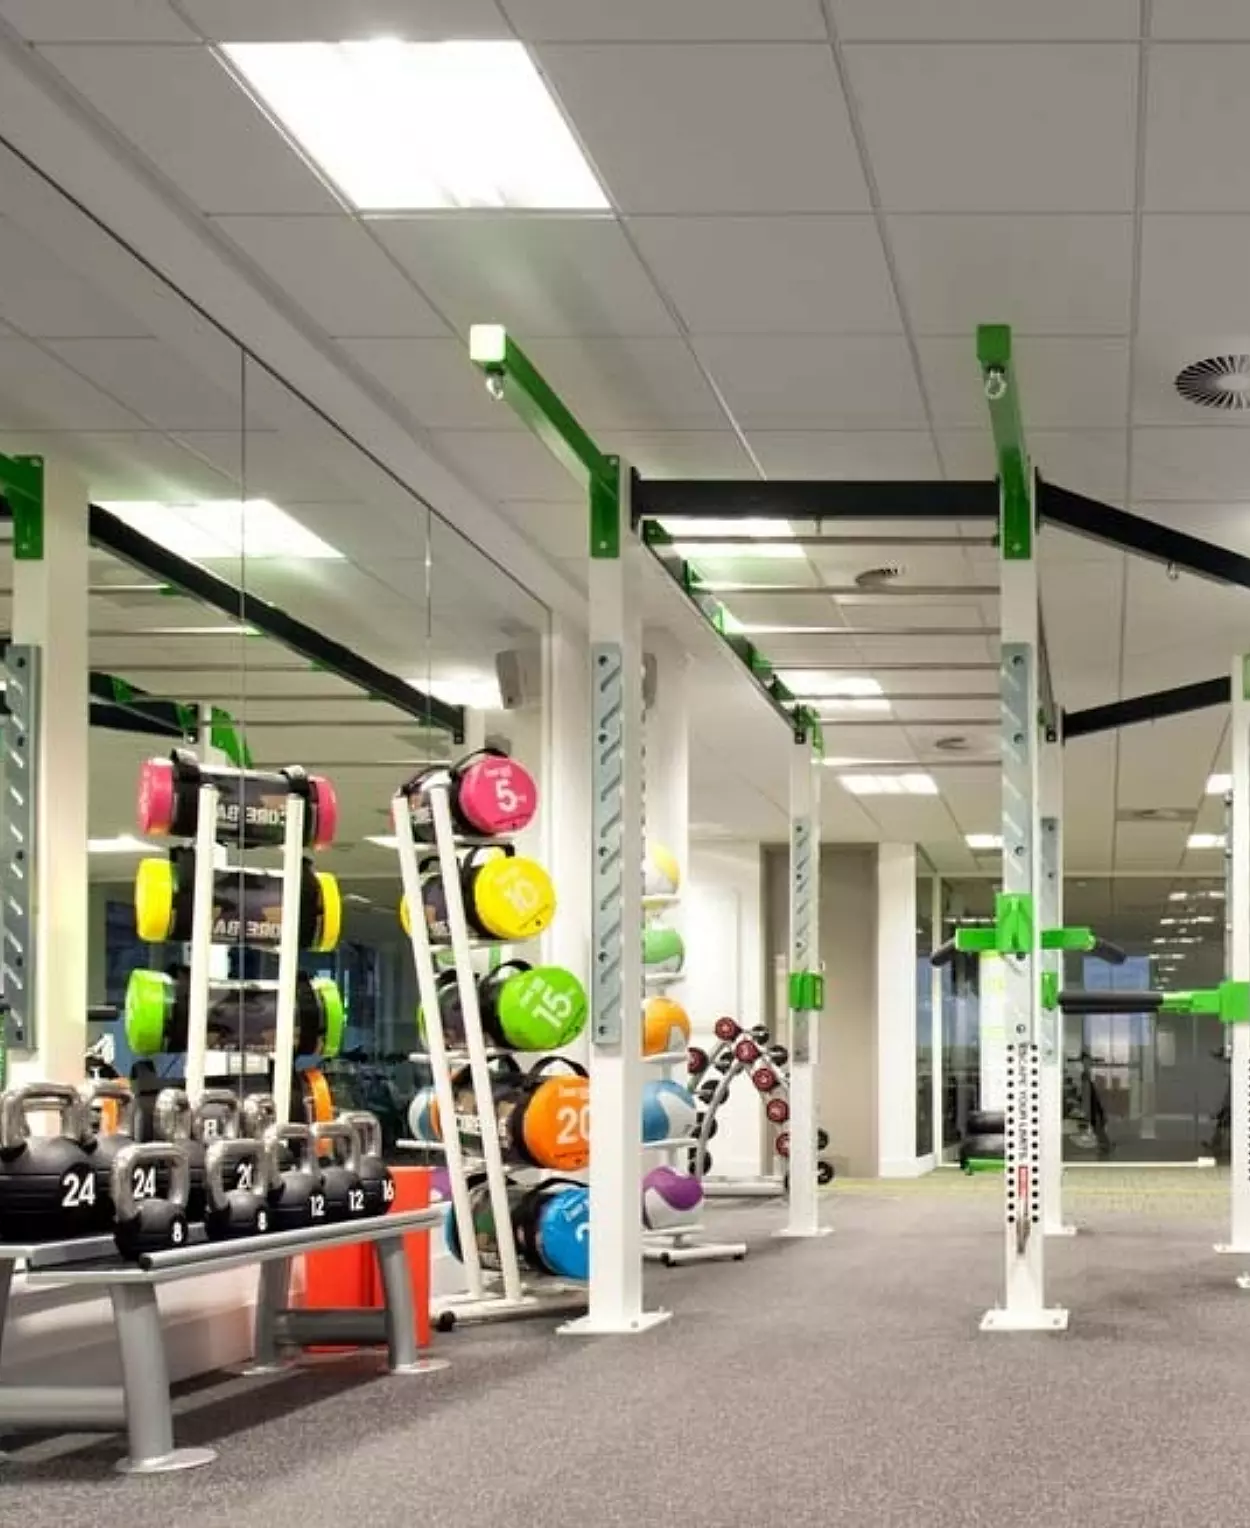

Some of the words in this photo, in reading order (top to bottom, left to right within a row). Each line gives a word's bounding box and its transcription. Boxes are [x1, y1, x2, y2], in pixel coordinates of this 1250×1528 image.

[496, 778, 518, 812] 5
[531, 984, 572, 1029] 15
[61, 1172, 96, 1208] 24
[133, 1167, 157, 1199] 24
[382, 1179, 395, 1201] 16
[309, 1195, 326, 1217] 12
[348, 1190, 365, 1211] 12
[173, 1221, 183, 1244] 8
[257, 1210, 267, 1232] 8
